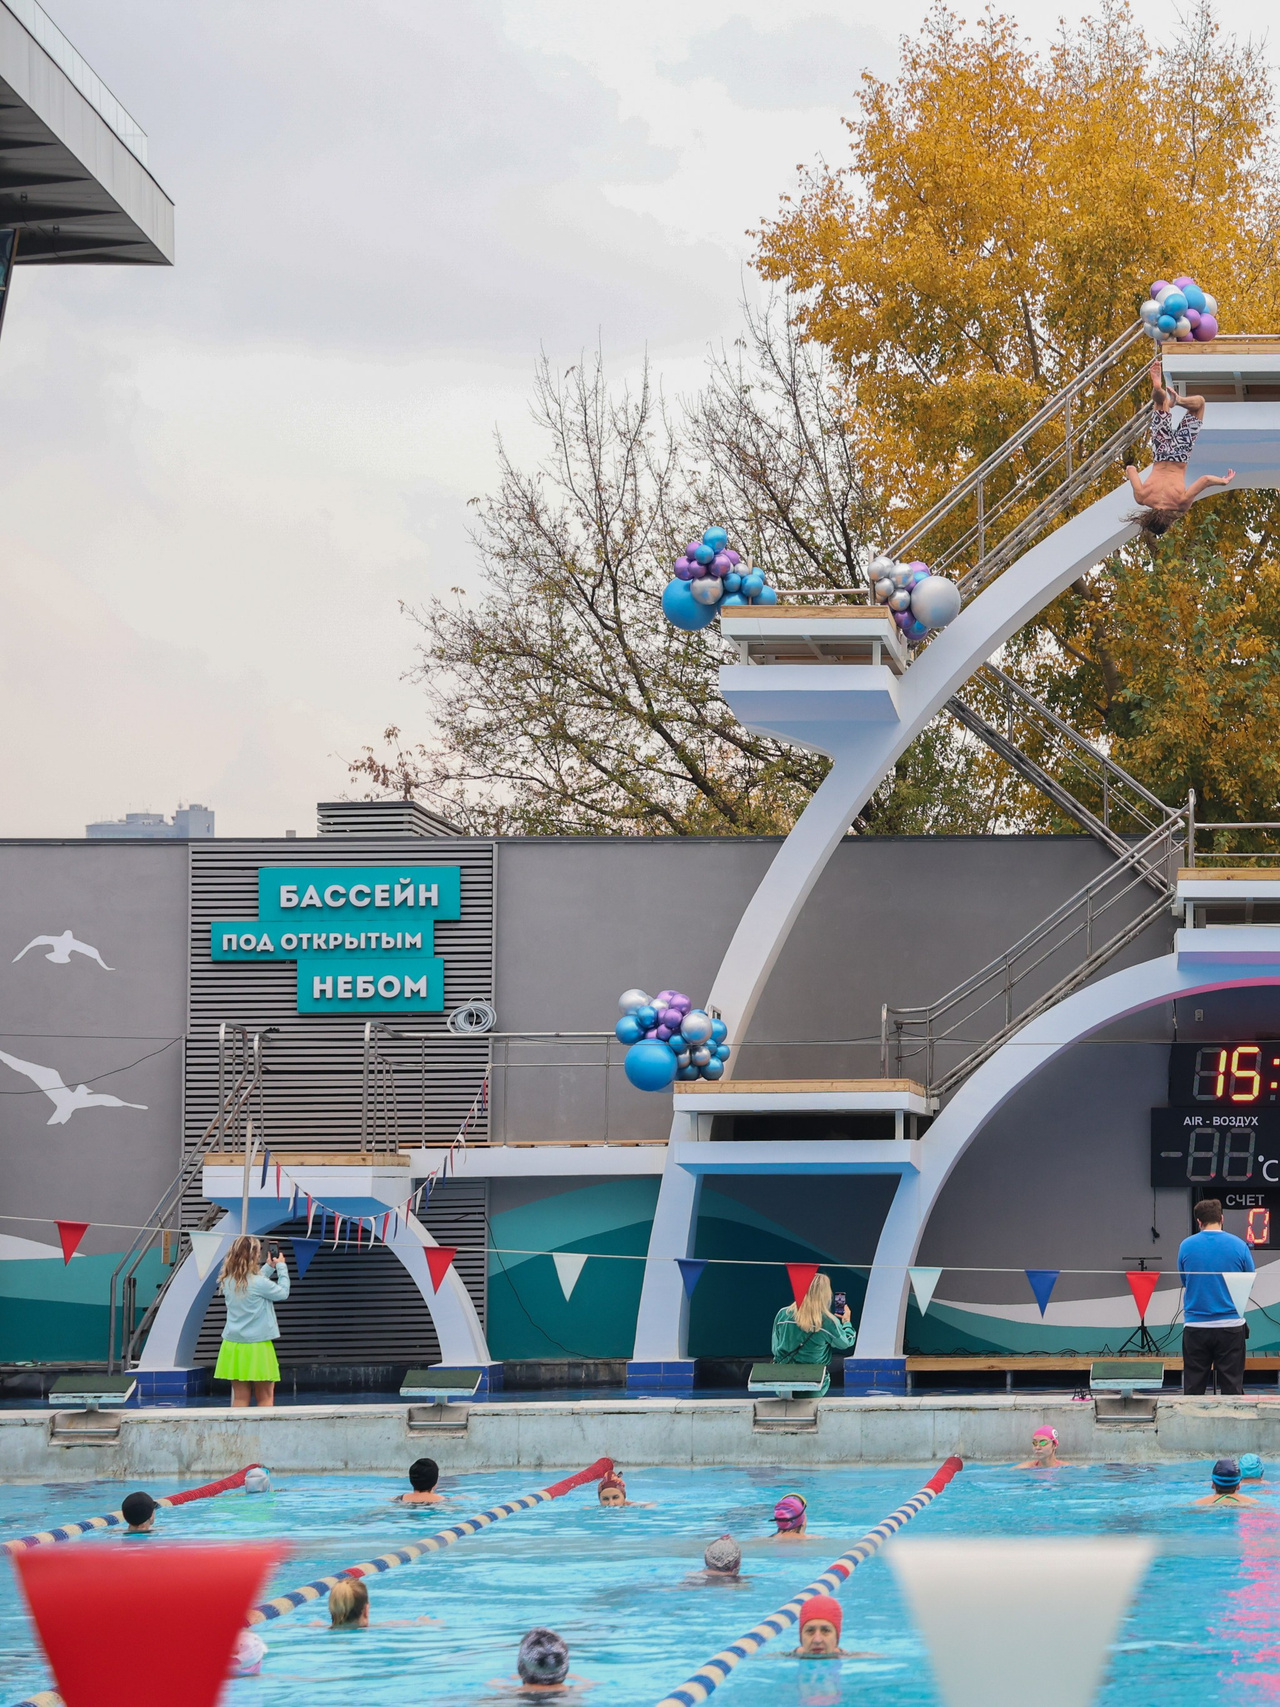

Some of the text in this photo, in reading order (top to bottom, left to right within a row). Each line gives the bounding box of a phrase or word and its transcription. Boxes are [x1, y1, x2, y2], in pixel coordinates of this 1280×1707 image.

[280, 877, 439, 908] БАССЕЙН
[222, 931, 422, 952] ПОД ОТКРЫТЫМ
[312, 975, 428, 999] НЕБОМ
[1183, 1116, 1204, 1126] AIR
[1212, 1116, 1259, 1127] ВОЗДУХ
[1225, 1194, 1265, 1206] СЧЕТ
